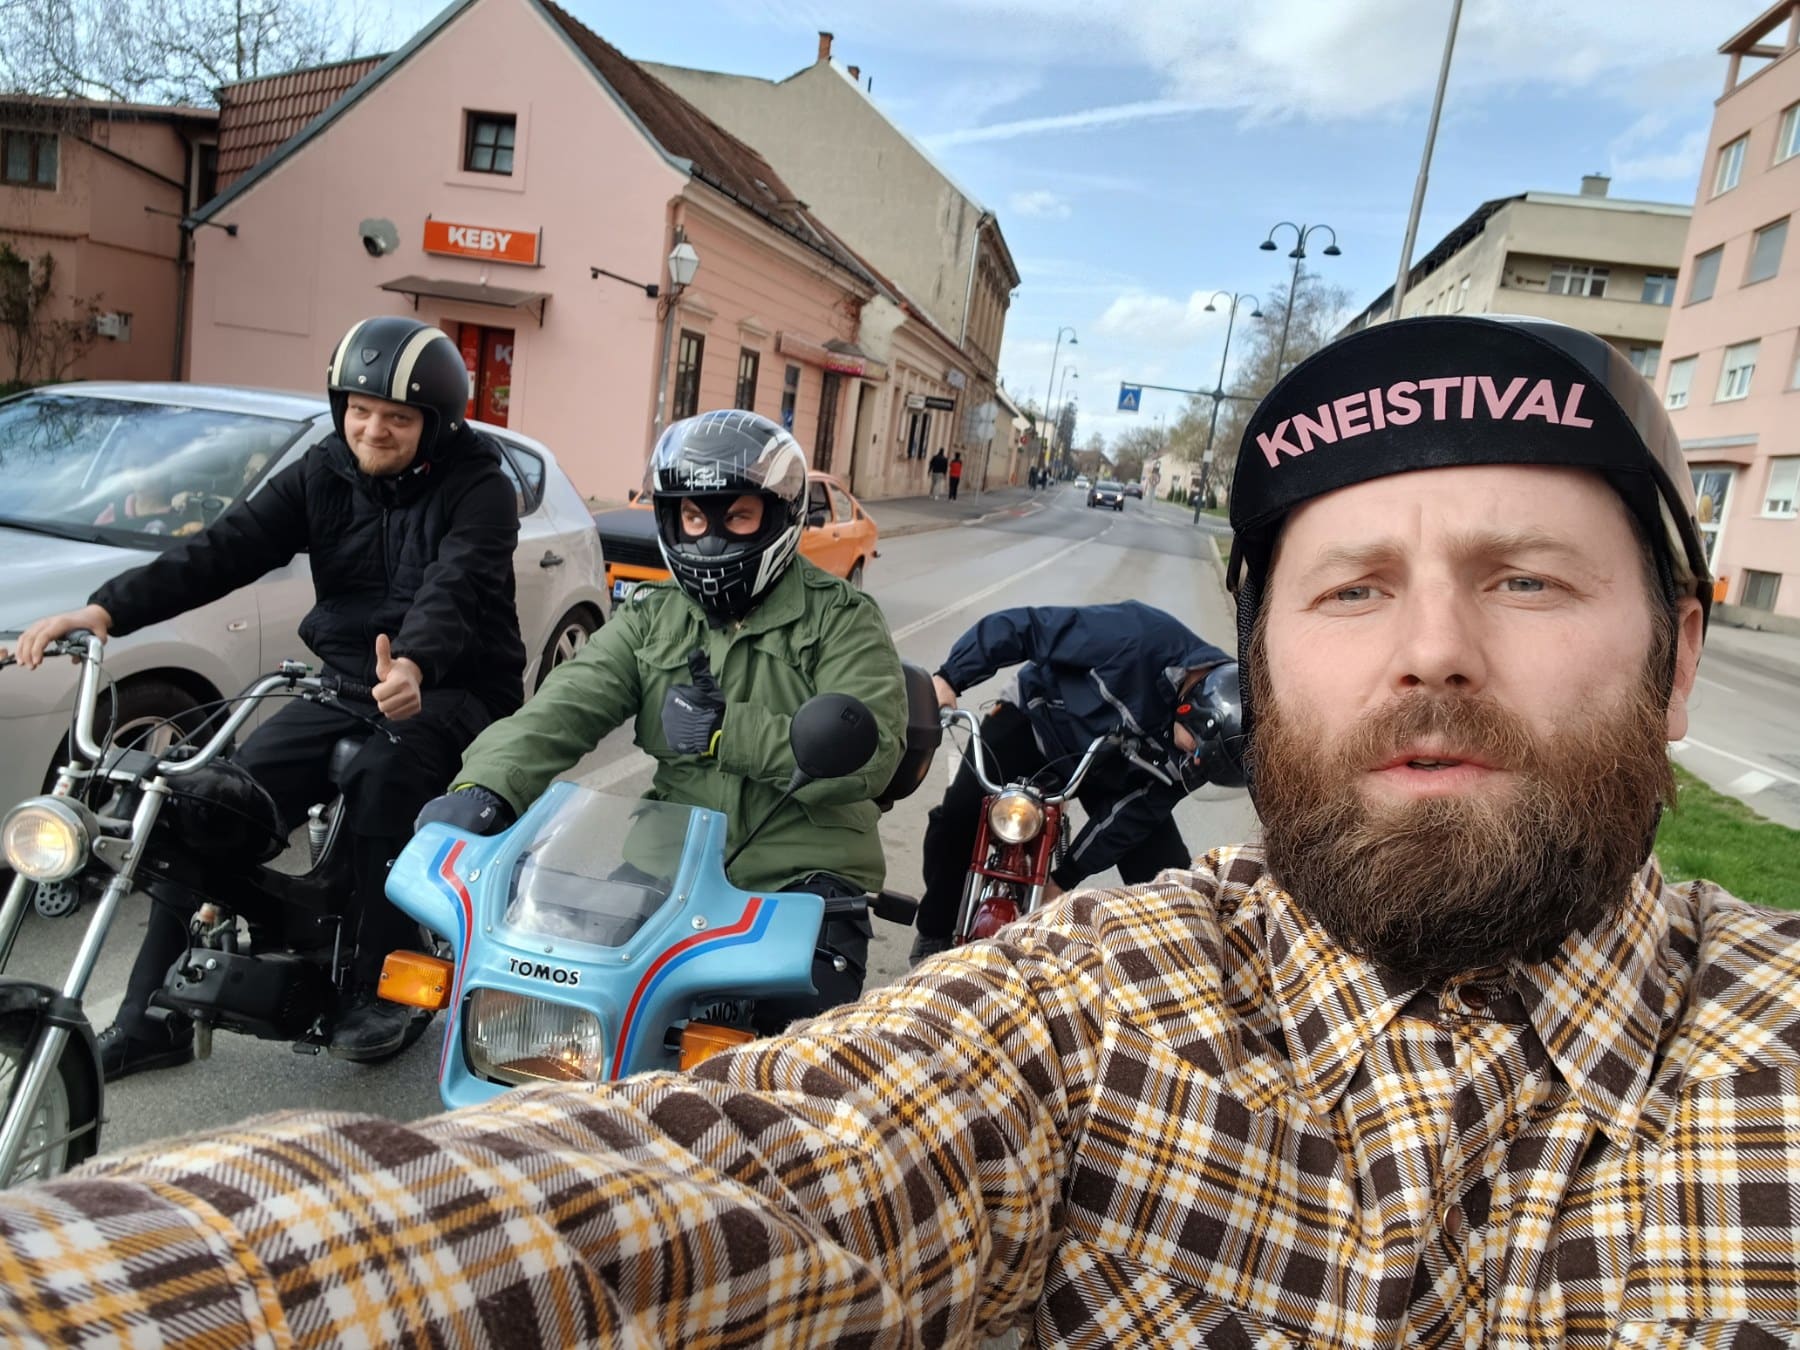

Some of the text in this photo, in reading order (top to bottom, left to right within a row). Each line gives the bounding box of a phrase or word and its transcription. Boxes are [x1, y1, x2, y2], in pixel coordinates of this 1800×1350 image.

[448, 225, 512, 253] KEBY
[1255, 375, 1595, 469] KNEISTIVAL
[510, 957, 579, 986] TOMOS
